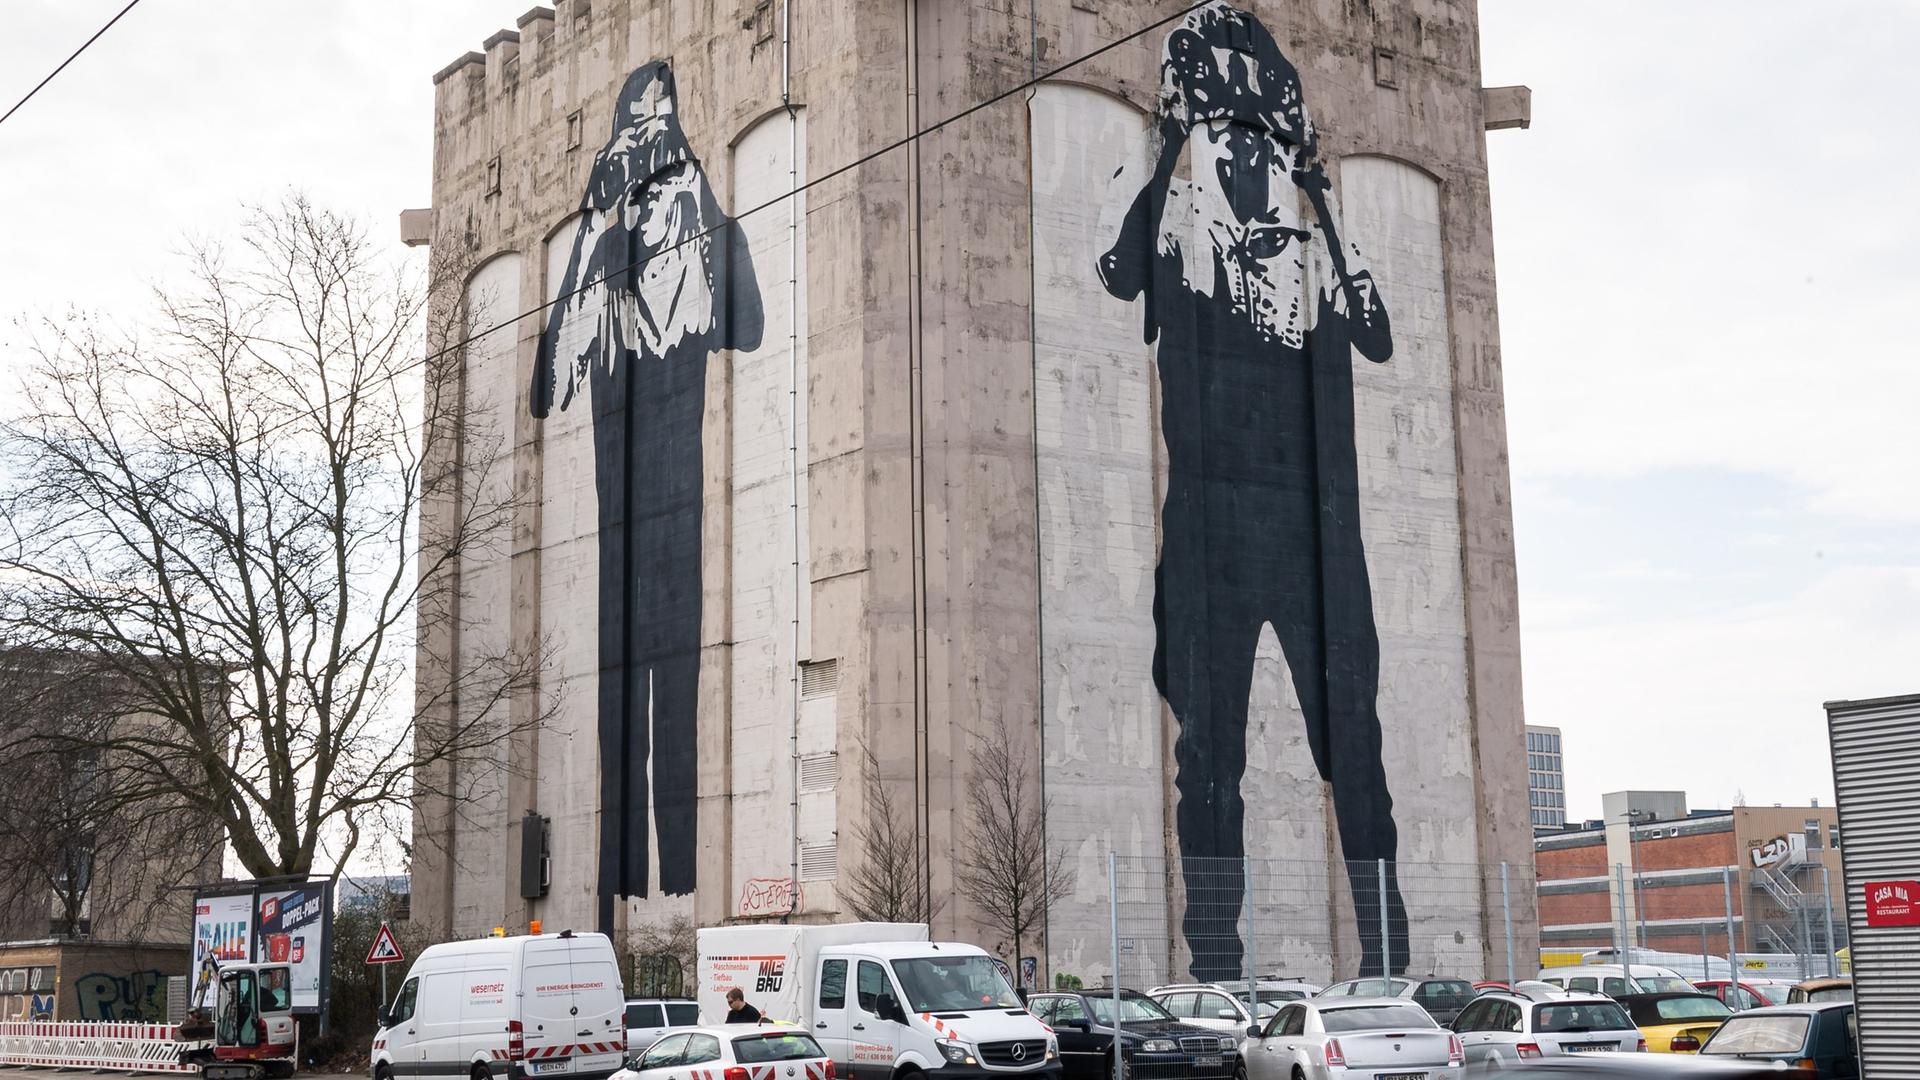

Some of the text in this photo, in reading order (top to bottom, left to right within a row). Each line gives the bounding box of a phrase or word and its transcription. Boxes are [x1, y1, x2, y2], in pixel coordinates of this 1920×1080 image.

[1874, 886, 1909, 903] CASA MIA
[282, 896, 320, 929] DOPPEL-PACK
[1876, 908, 1910, 916] RESTAURANT
[713, 962, 749, 970] Maschinenbau
[1745, 960, 1764, 968] Hertz
[713, 973, 733, 981] Tiefbau
[471, 982, 504, 993] wesernetz
[755, 977, 783, 992] BAU
